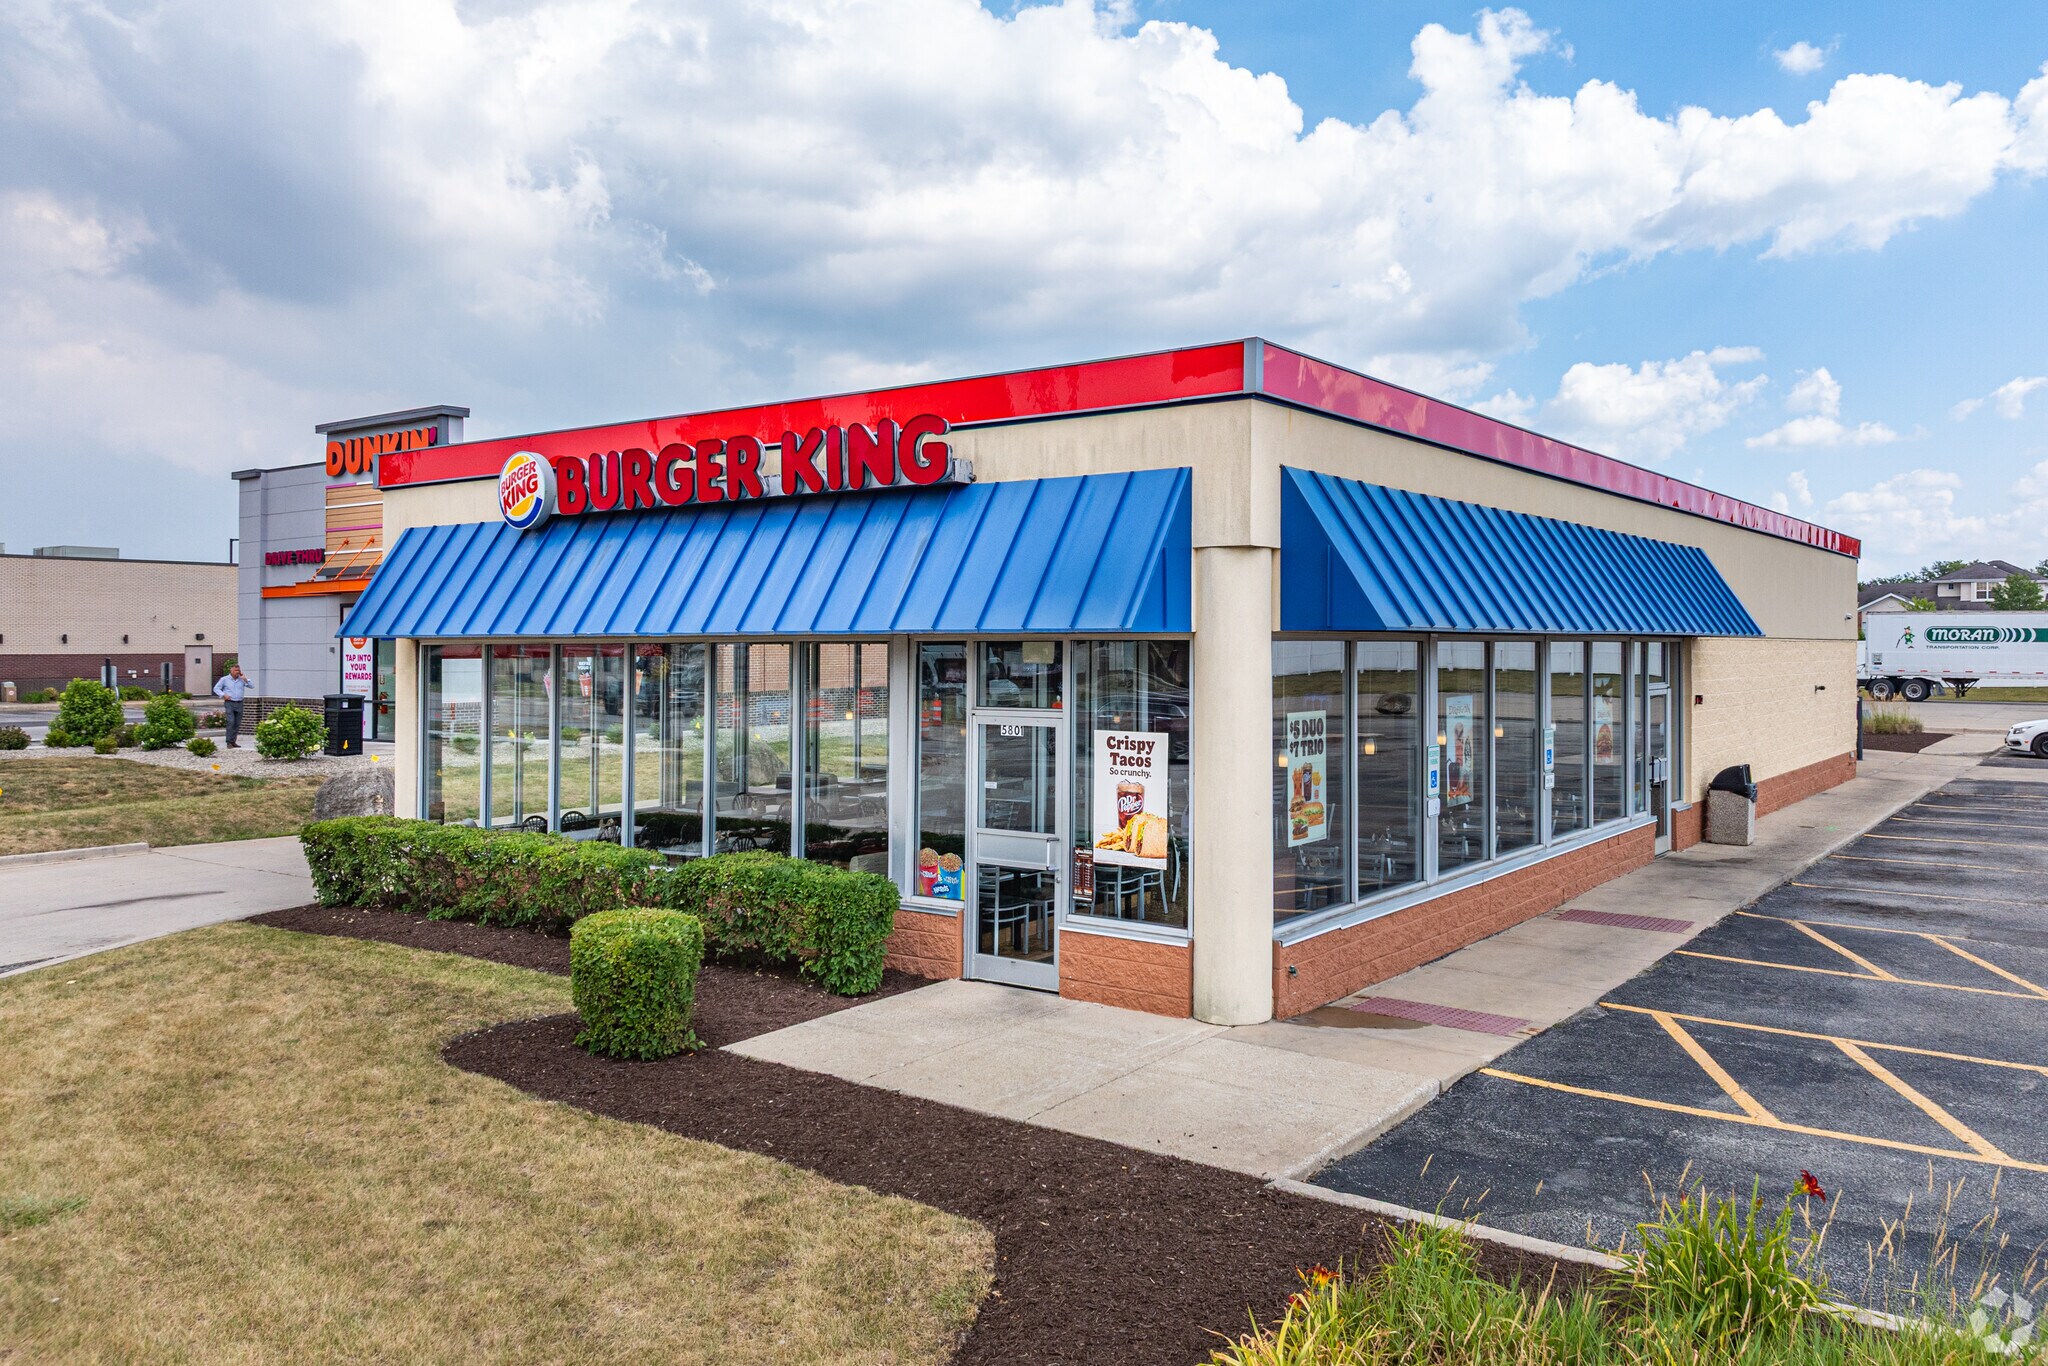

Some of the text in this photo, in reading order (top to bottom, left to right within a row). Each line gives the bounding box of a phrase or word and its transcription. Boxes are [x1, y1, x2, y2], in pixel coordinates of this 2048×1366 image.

[556, 413, 953, 516] BURGER KING
[501, 461, 536, 495] BURGER
[503, 474, 538, 515] KING
[1931, 629, 1995, 641] MORAN
[345, 654, 372, 662] TAP INTO
[350, 663, 367, 671] YOUR
[345, 672, 372, 680] REWARDS
[1290, 718, 1324, 739] $5 DUO
[1106, 735, 1156, 755] Crispy
[1290, 738, 1324, 757] $7 TRIO
[1110, 752, 1152, 768] Tacos
[1109, 767, 1152, 779] So crunchy.
